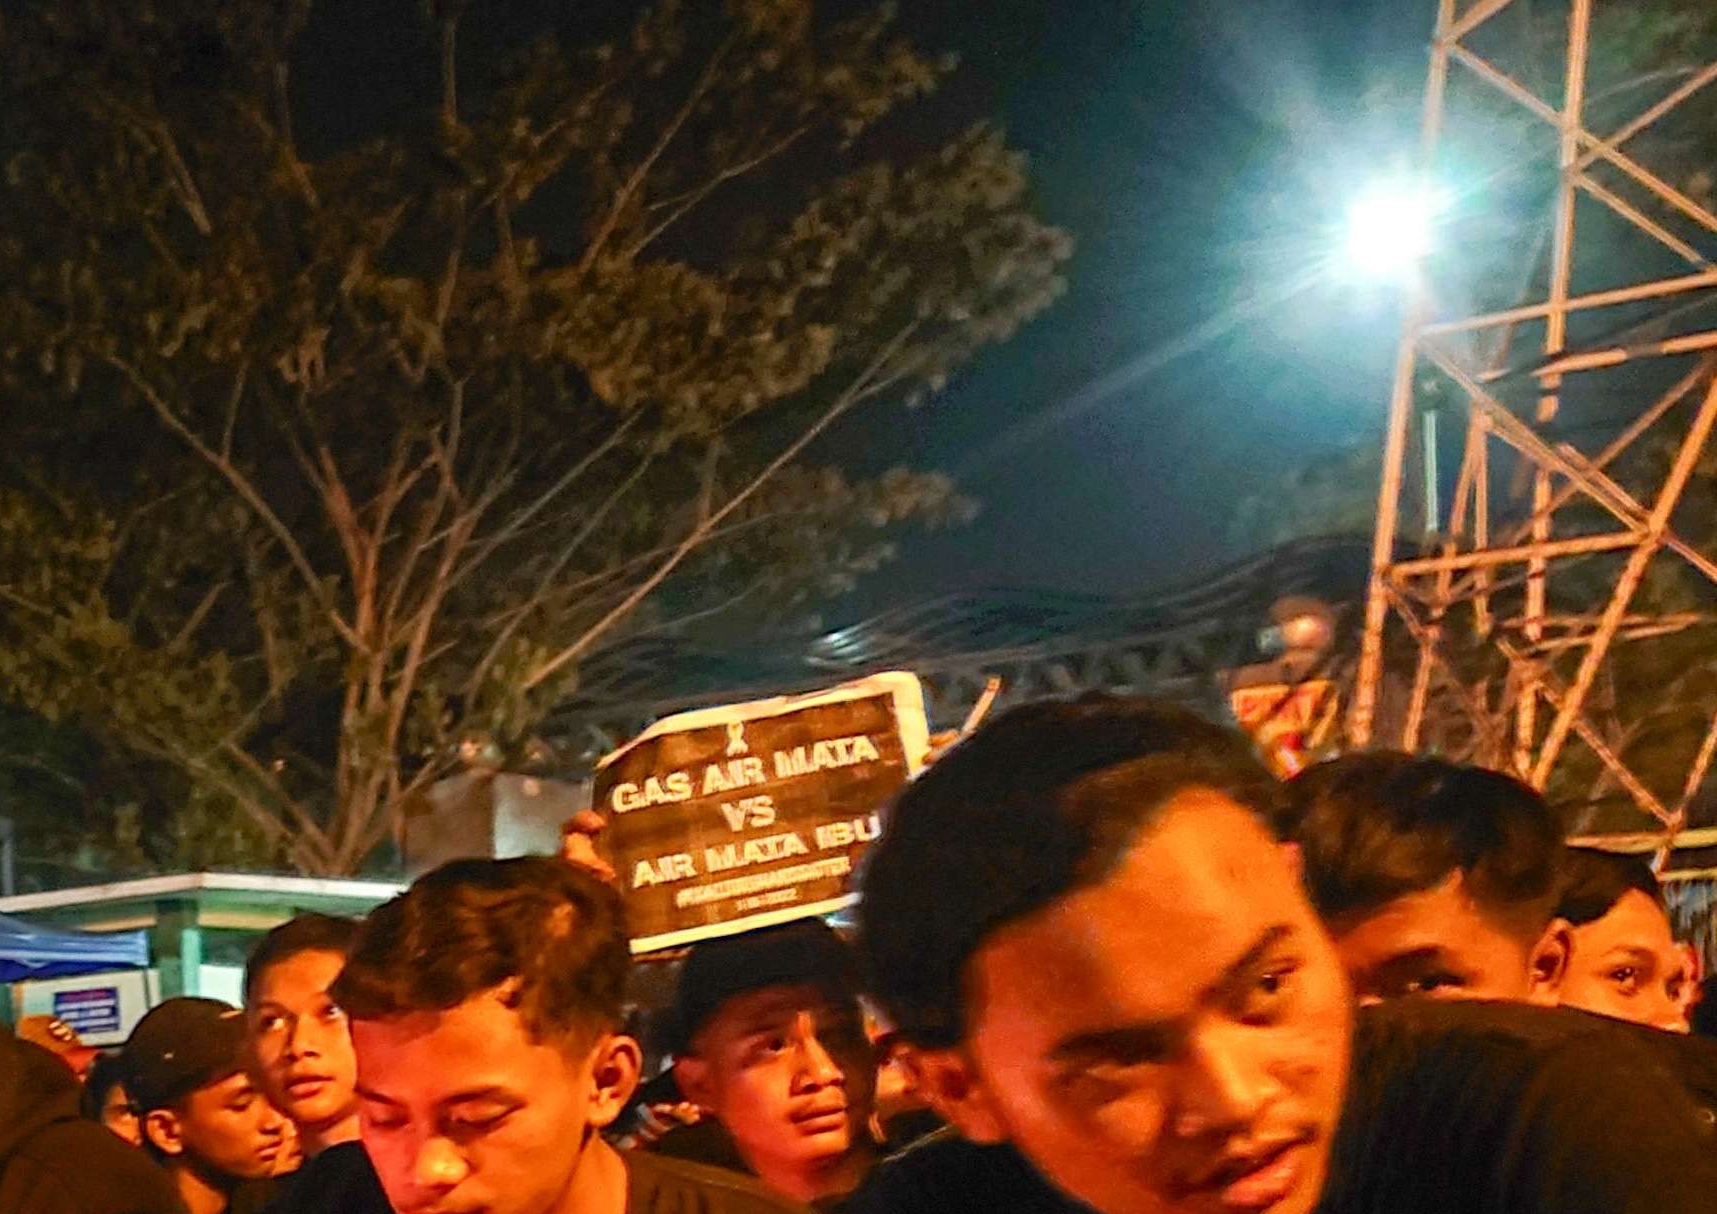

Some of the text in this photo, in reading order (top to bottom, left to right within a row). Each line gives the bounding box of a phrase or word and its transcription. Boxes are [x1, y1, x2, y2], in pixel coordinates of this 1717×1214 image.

[611, 735, 880, 814] GAS AIR MATA
[721, 795, 777, 832] VS
[633, 853, 698, 889] AIR
[705, 832, 809, 873] MATA
[815, 815, 882, 850] IBU
